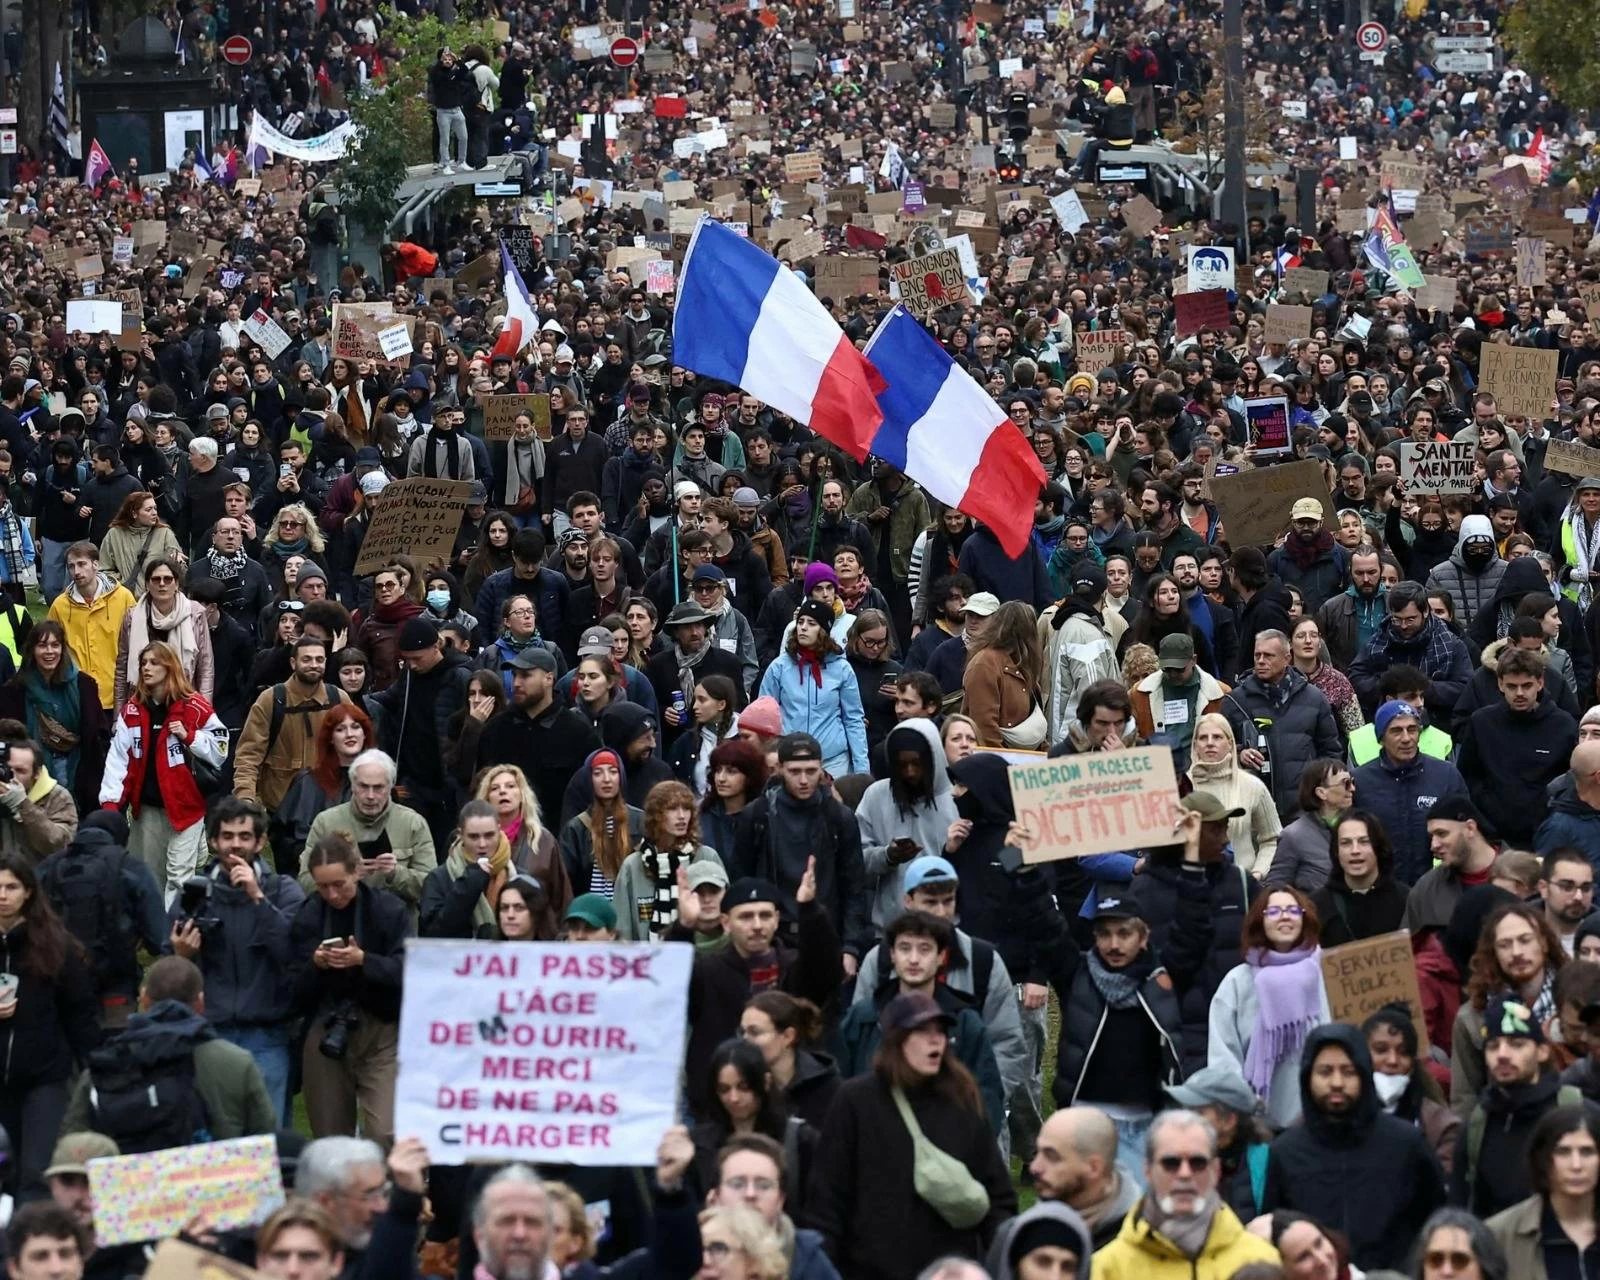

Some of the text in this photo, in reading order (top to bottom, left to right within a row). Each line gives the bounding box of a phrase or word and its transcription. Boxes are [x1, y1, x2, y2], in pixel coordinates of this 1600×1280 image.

[1364, 32, 1379, 43] 50
[1080, 343, 1106, 355] MAIS
[1488, 350, 1552, 370] PAS BESOIN
[487, 396, 526, 408] PANEM
[1512, 396, 1547, 414] BOMBE
[1409, 442, 1474, 463] SANTE
[1404, 479, 1421, 491] ÇA
[1421, 478, 1447, 488] VOUS
[402, 510, 417, 526] ÇA
[432, 525, 457, 535] PLUS
[1012, 762, 1082, 792] MACRON
[1020, 788, 1179, 852] DICTATURE
[453, 953, 519, 978] J'AI
[1325, 944, 1411, 978] SERVICES
[497, 986, 598, 1016] L'ÂGE
[429, 1022, 474, 1046] DE
[481, 1056, 594, 1082] MERCI
[437, 1087, 619, 1116] DE NE PAS
[438, 1123, 612, 1149] CHARGER
